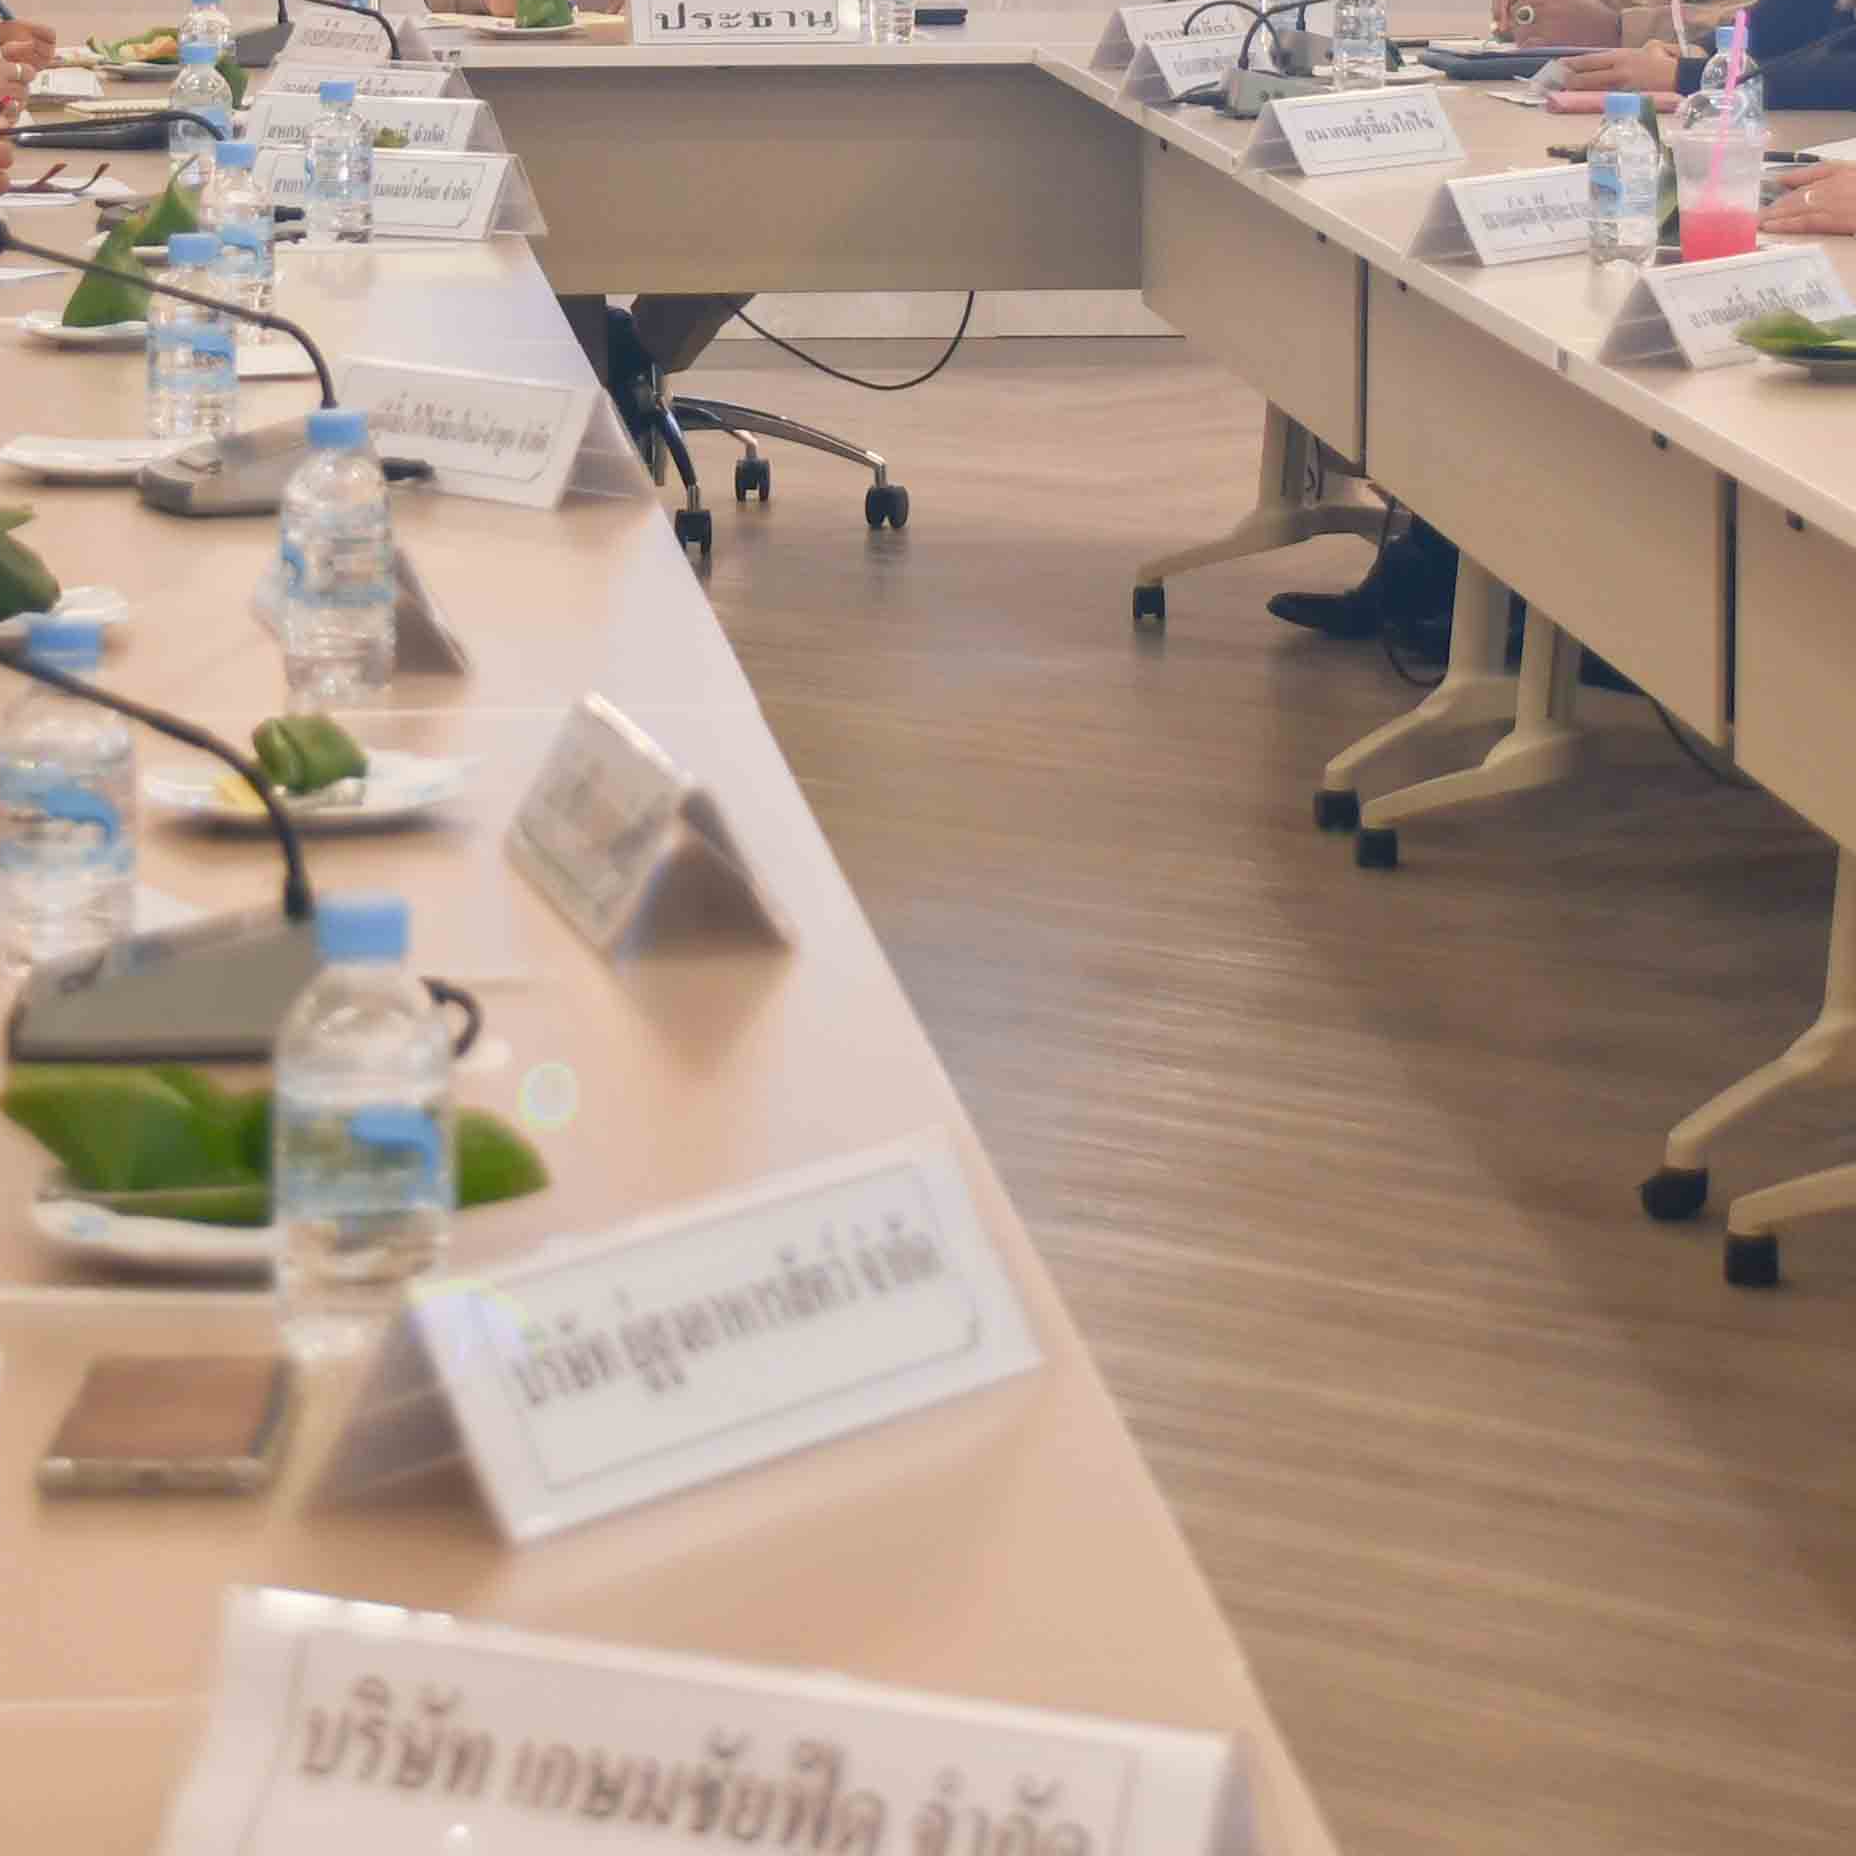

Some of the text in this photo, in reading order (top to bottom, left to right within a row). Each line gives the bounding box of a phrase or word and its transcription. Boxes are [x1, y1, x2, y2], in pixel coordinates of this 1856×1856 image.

[655, 2, 834, 32] ประธาน
[301, 1673, 497, 1798] บริษัท
